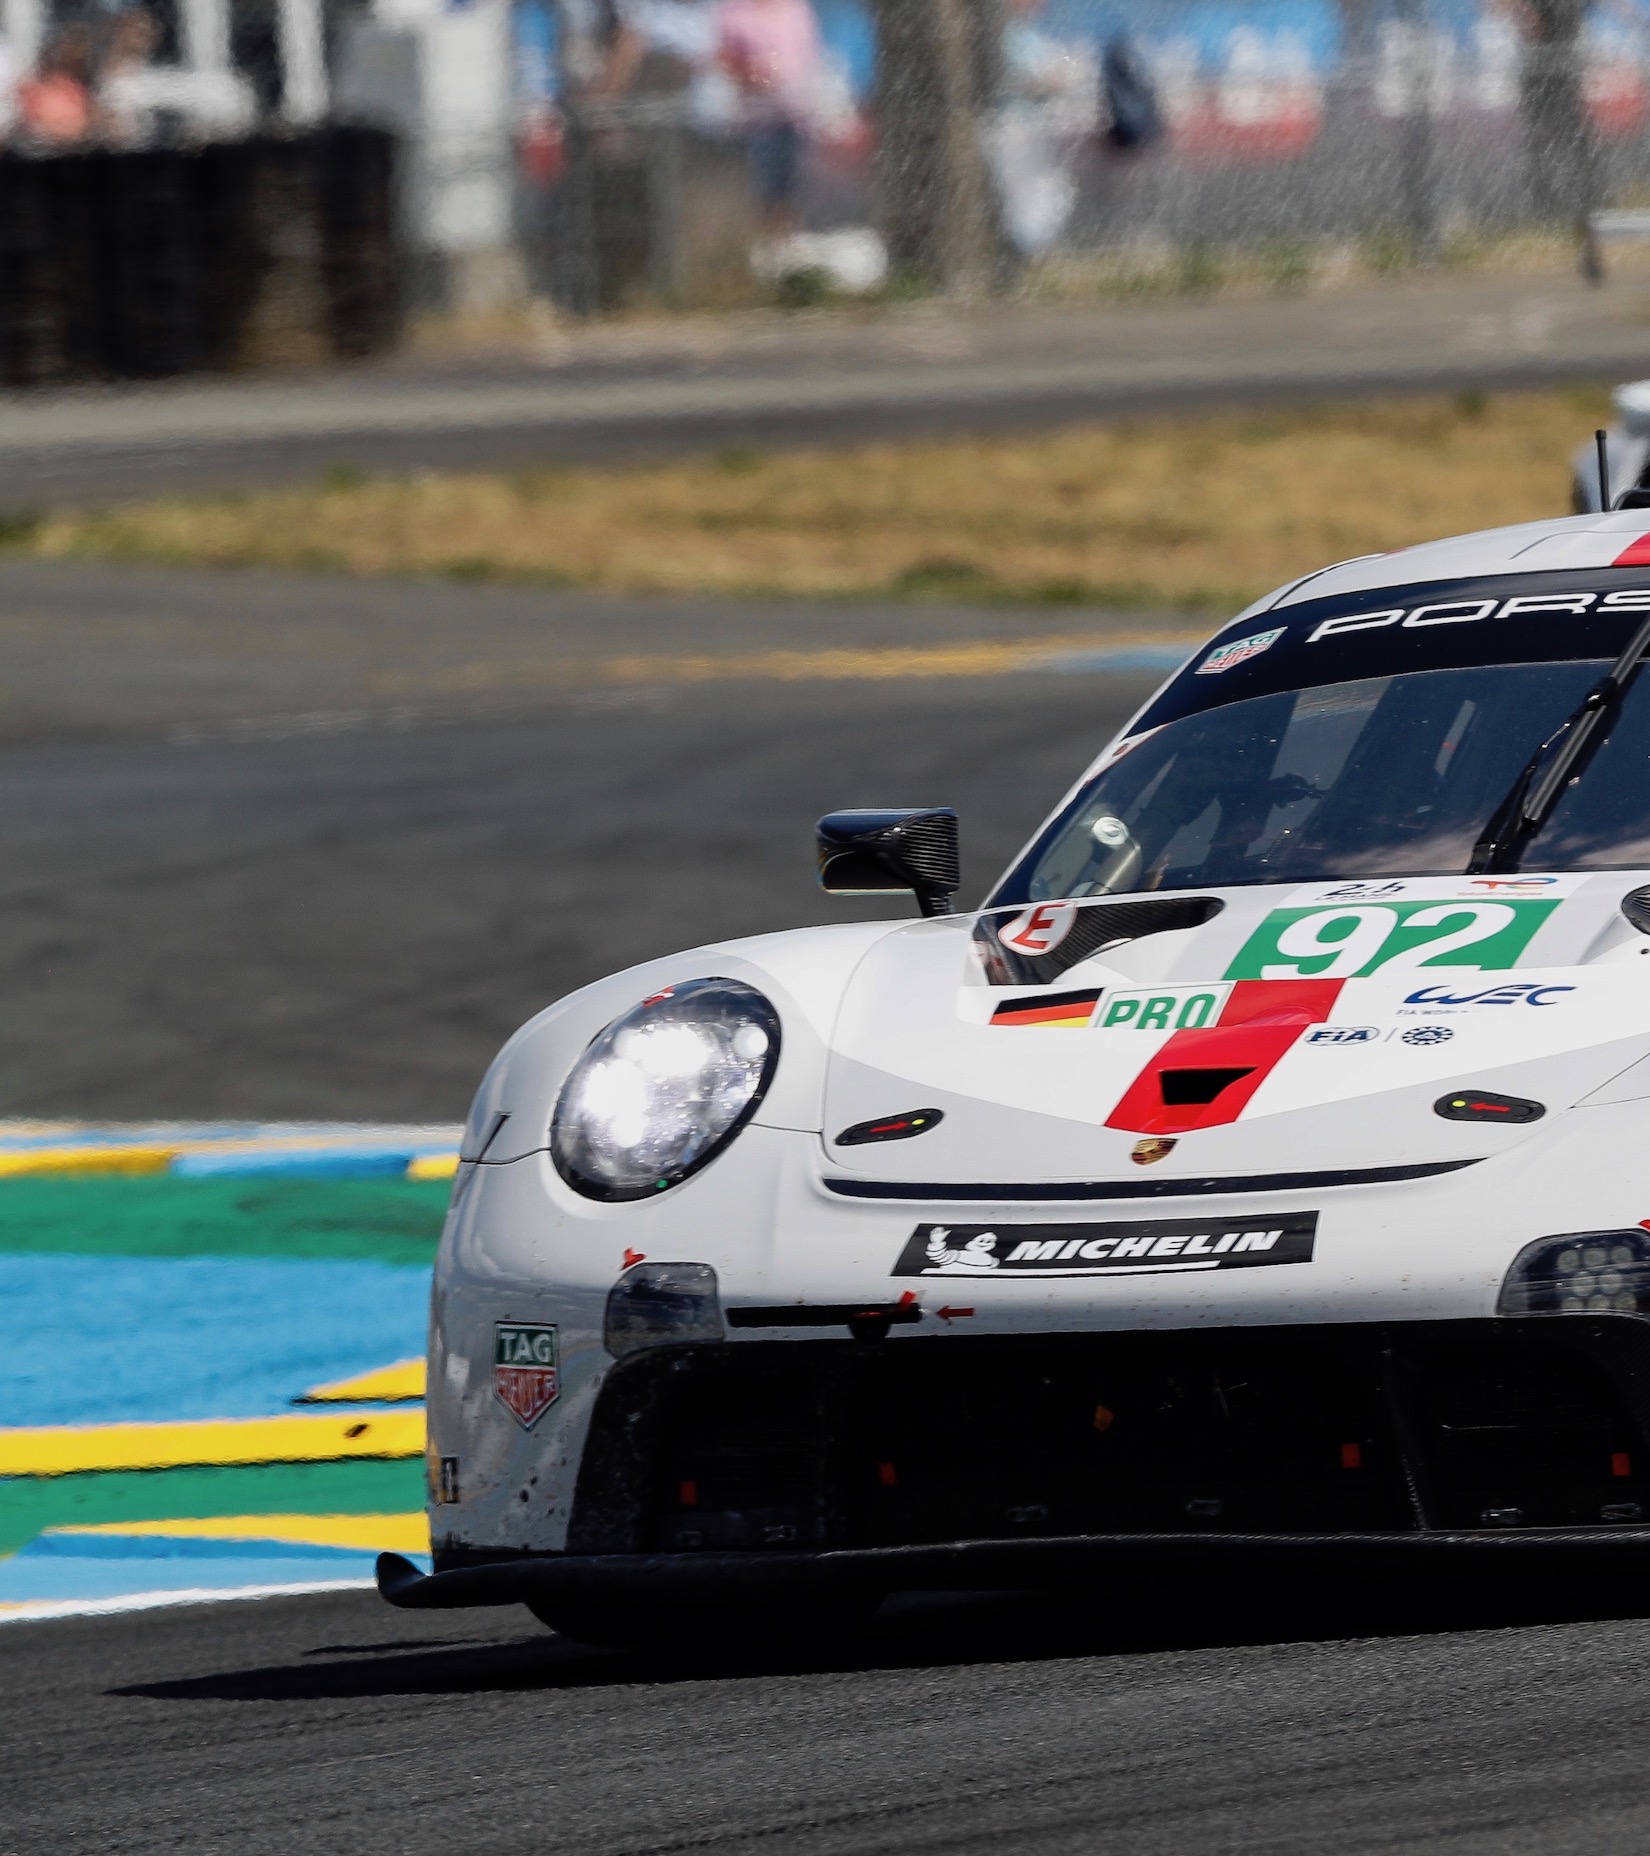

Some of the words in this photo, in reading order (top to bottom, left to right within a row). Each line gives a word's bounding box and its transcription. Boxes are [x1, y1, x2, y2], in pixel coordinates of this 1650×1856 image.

[1011, 903, 1070, 949] E
[1260, 902, 1517, 981] 92
[1104, 993, 1216, 1030] PRO
[1402, 984, 1577, 1007] WEC
[1005, 1230, 1284, 1262] MICHELIN
[500, 1332, 551, 1363] TAG
